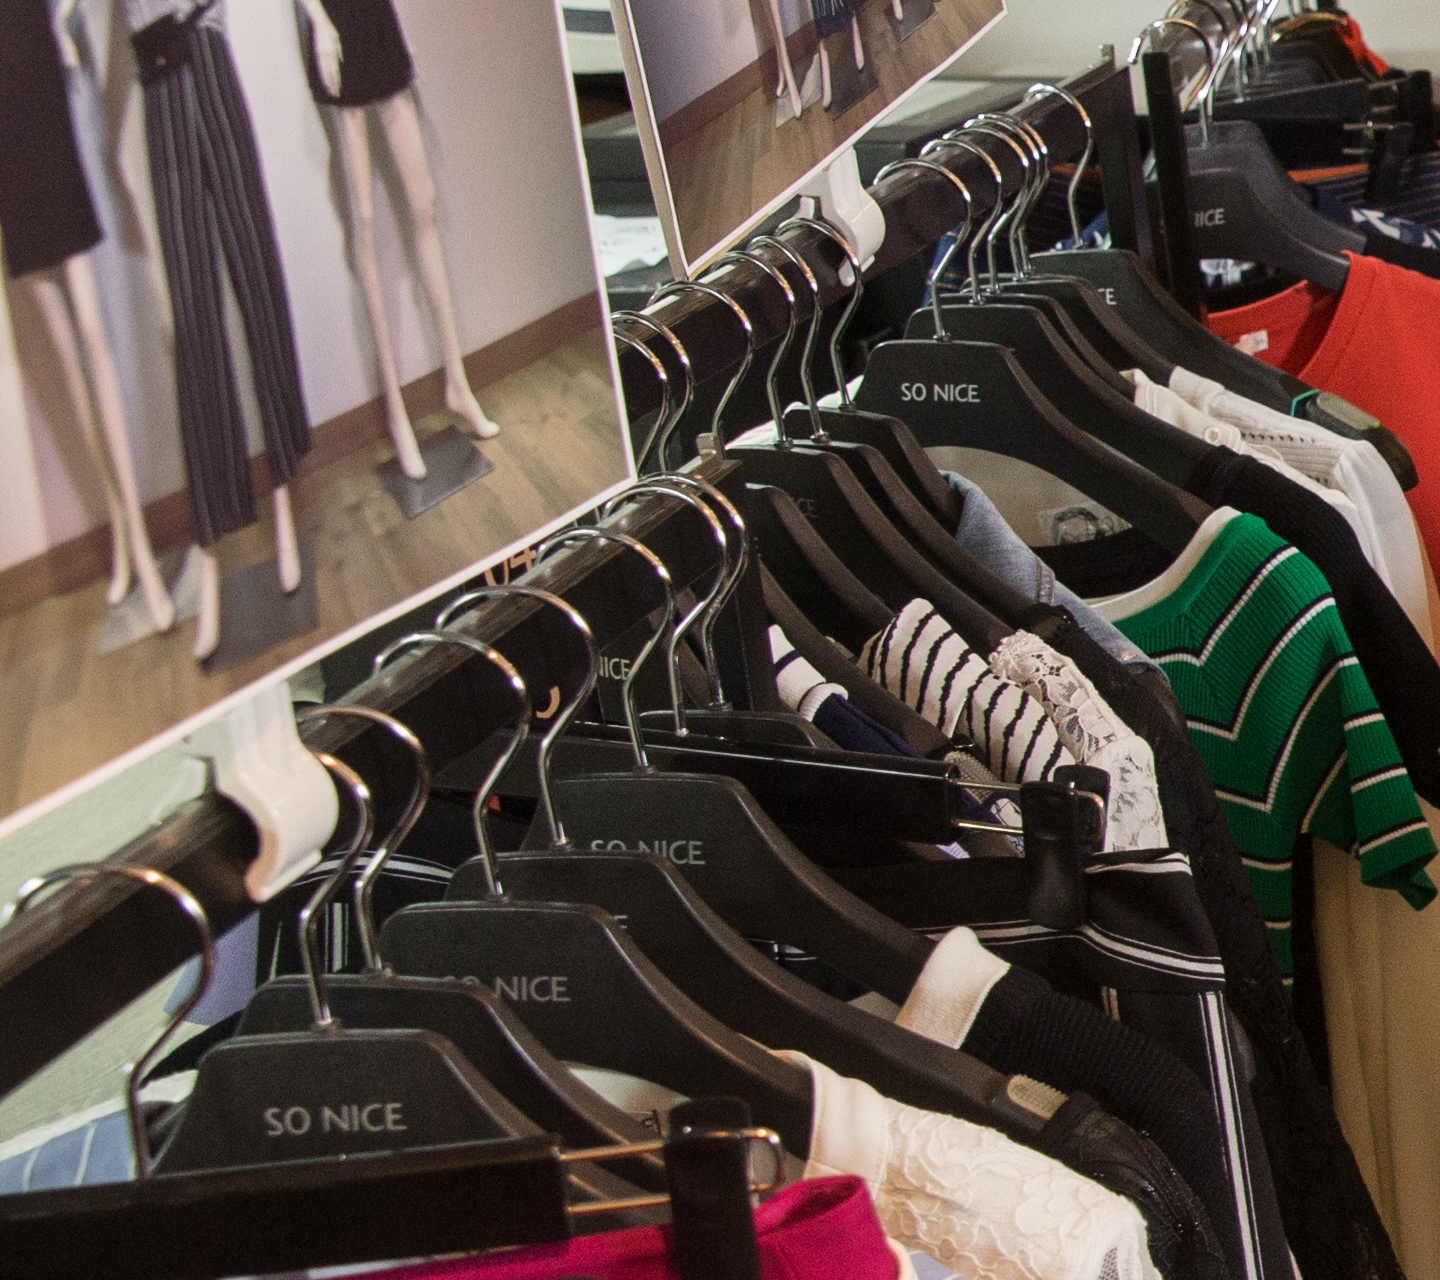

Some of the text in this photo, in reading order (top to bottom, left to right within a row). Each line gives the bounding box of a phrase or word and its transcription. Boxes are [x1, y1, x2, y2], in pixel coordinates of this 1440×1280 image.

[901, 383, 980, 402] SO NICE
[494, 975, 571, 1002] NICE
[263, 1102, 408, 1137] SO NICE
